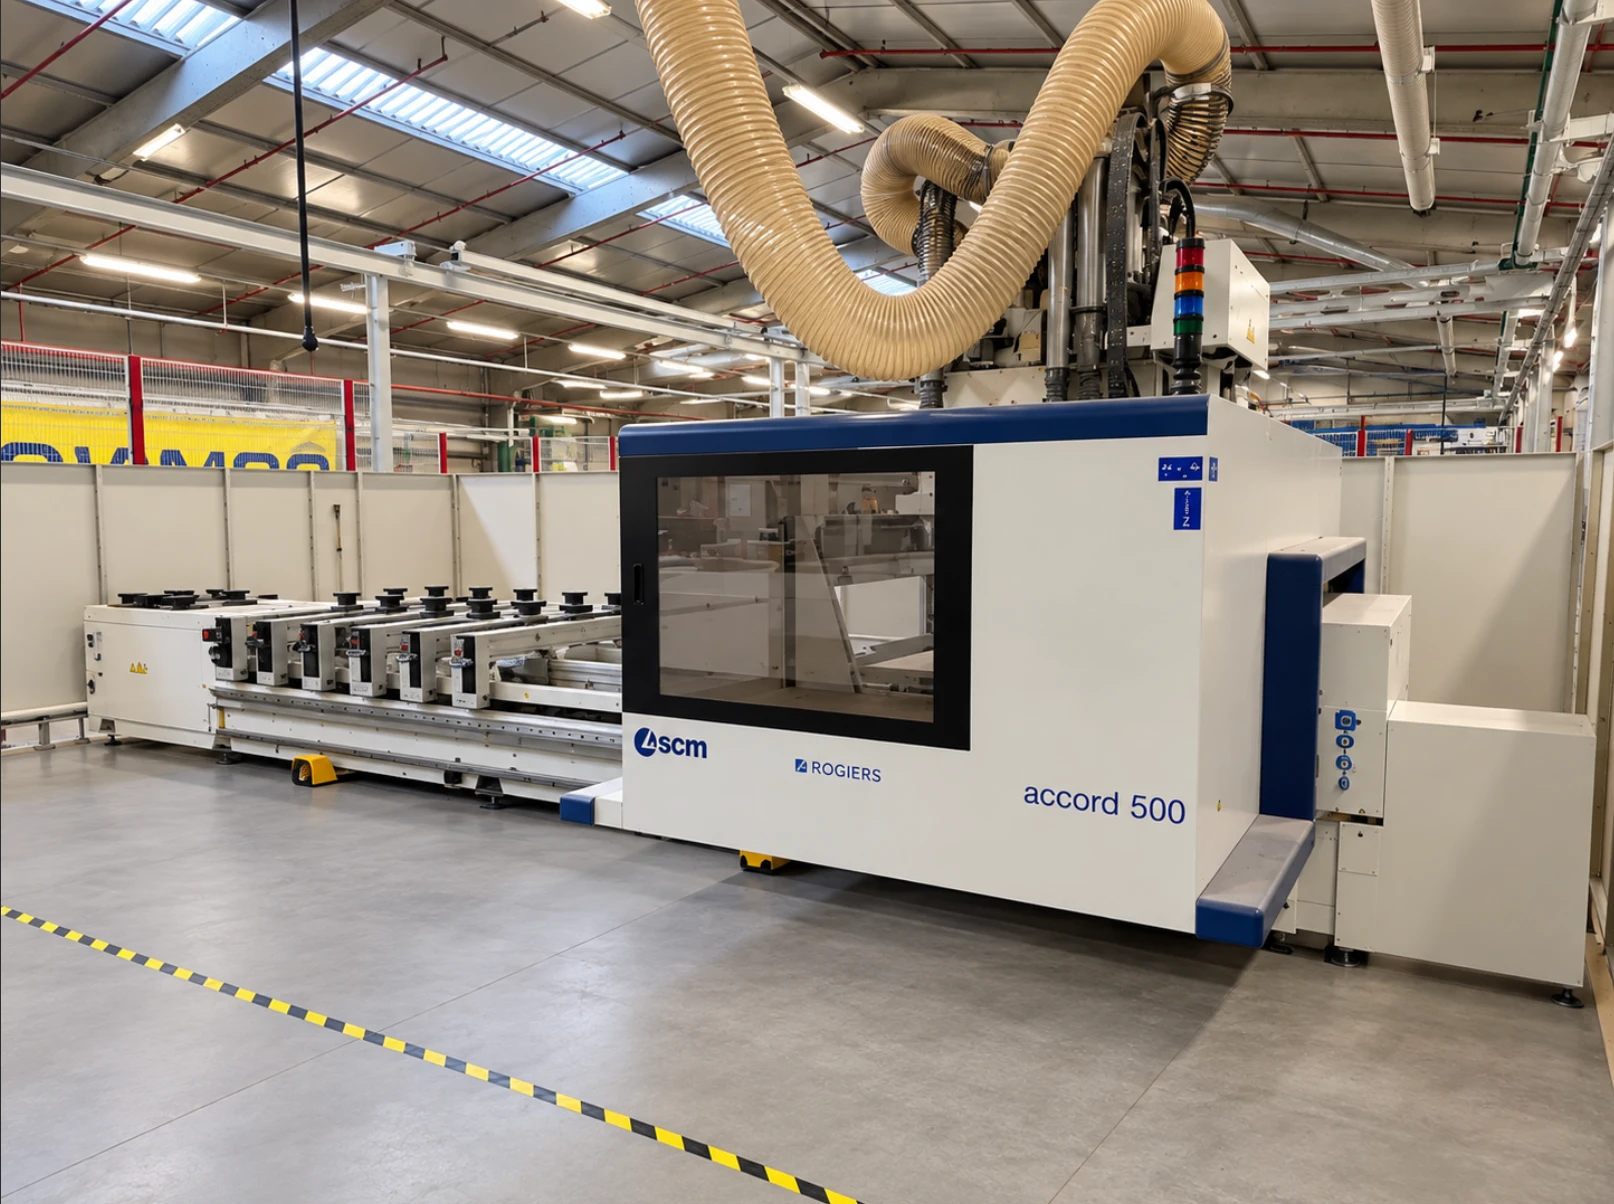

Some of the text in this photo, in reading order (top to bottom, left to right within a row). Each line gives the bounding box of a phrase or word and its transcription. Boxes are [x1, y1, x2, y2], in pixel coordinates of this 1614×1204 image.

[658, 736, 707, 758] scm
[811, 761, 882, 782] ROGIERS
[1024, 786, 1185, 824] accord 500
